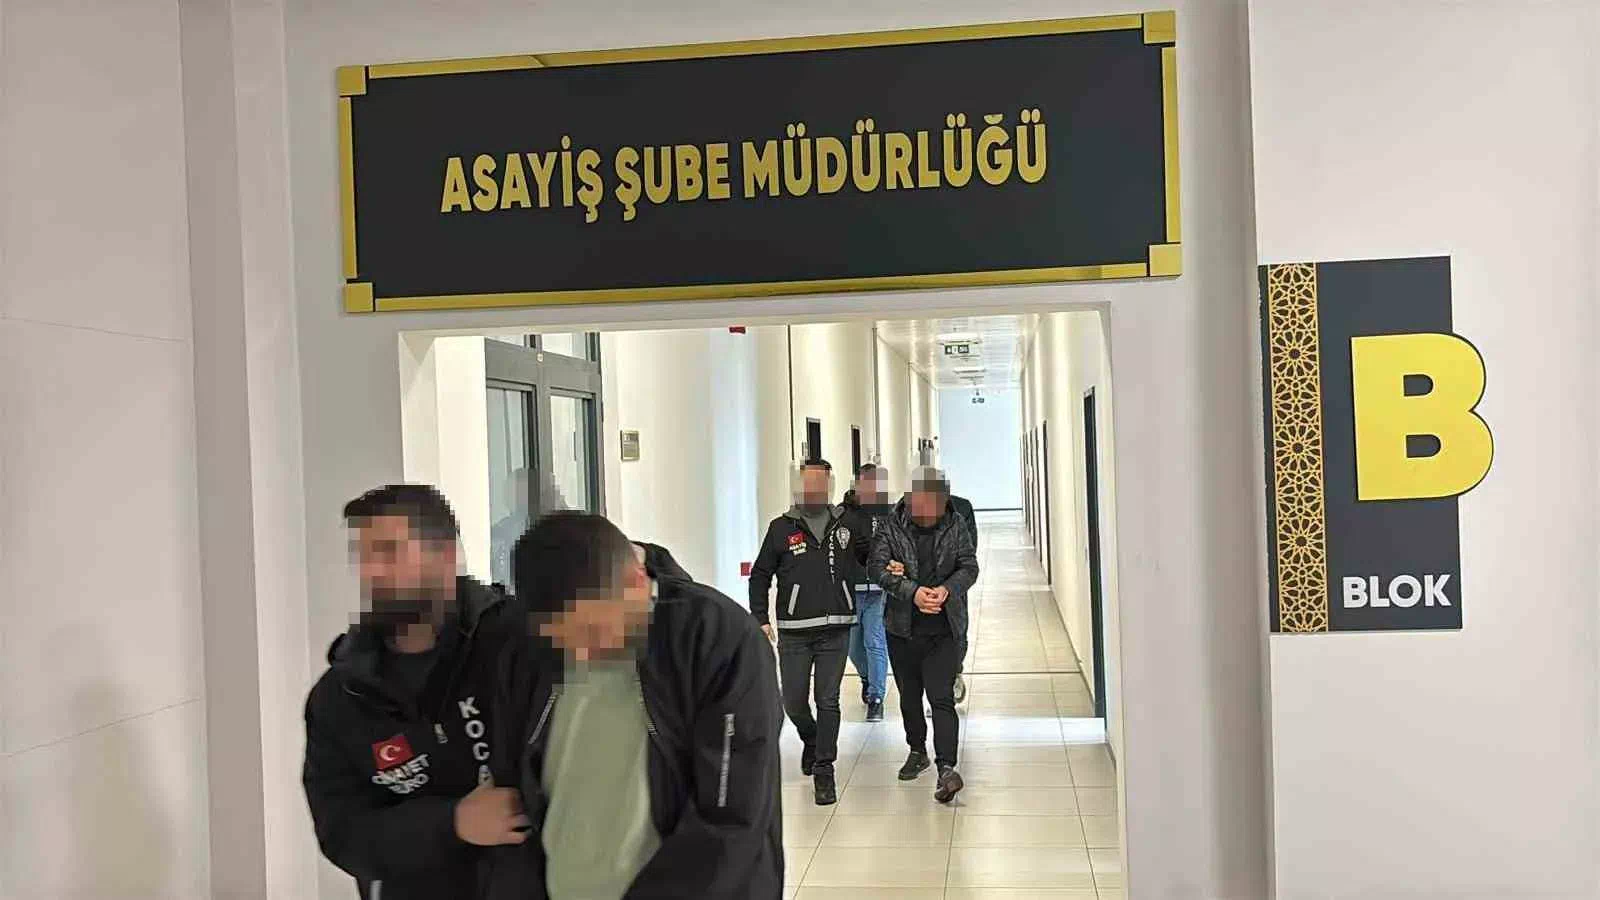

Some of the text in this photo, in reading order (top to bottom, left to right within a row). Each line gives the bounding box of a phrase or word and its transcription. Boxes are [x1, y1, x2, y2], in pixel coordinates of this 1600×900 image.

[440, 108, 1048, 223] ASAYİŞ ŞUBE MÜDÜRLÜĞÜ
[1351, 333, 1494, 501] B
[1342, 574, 1452, 608] BLOK
